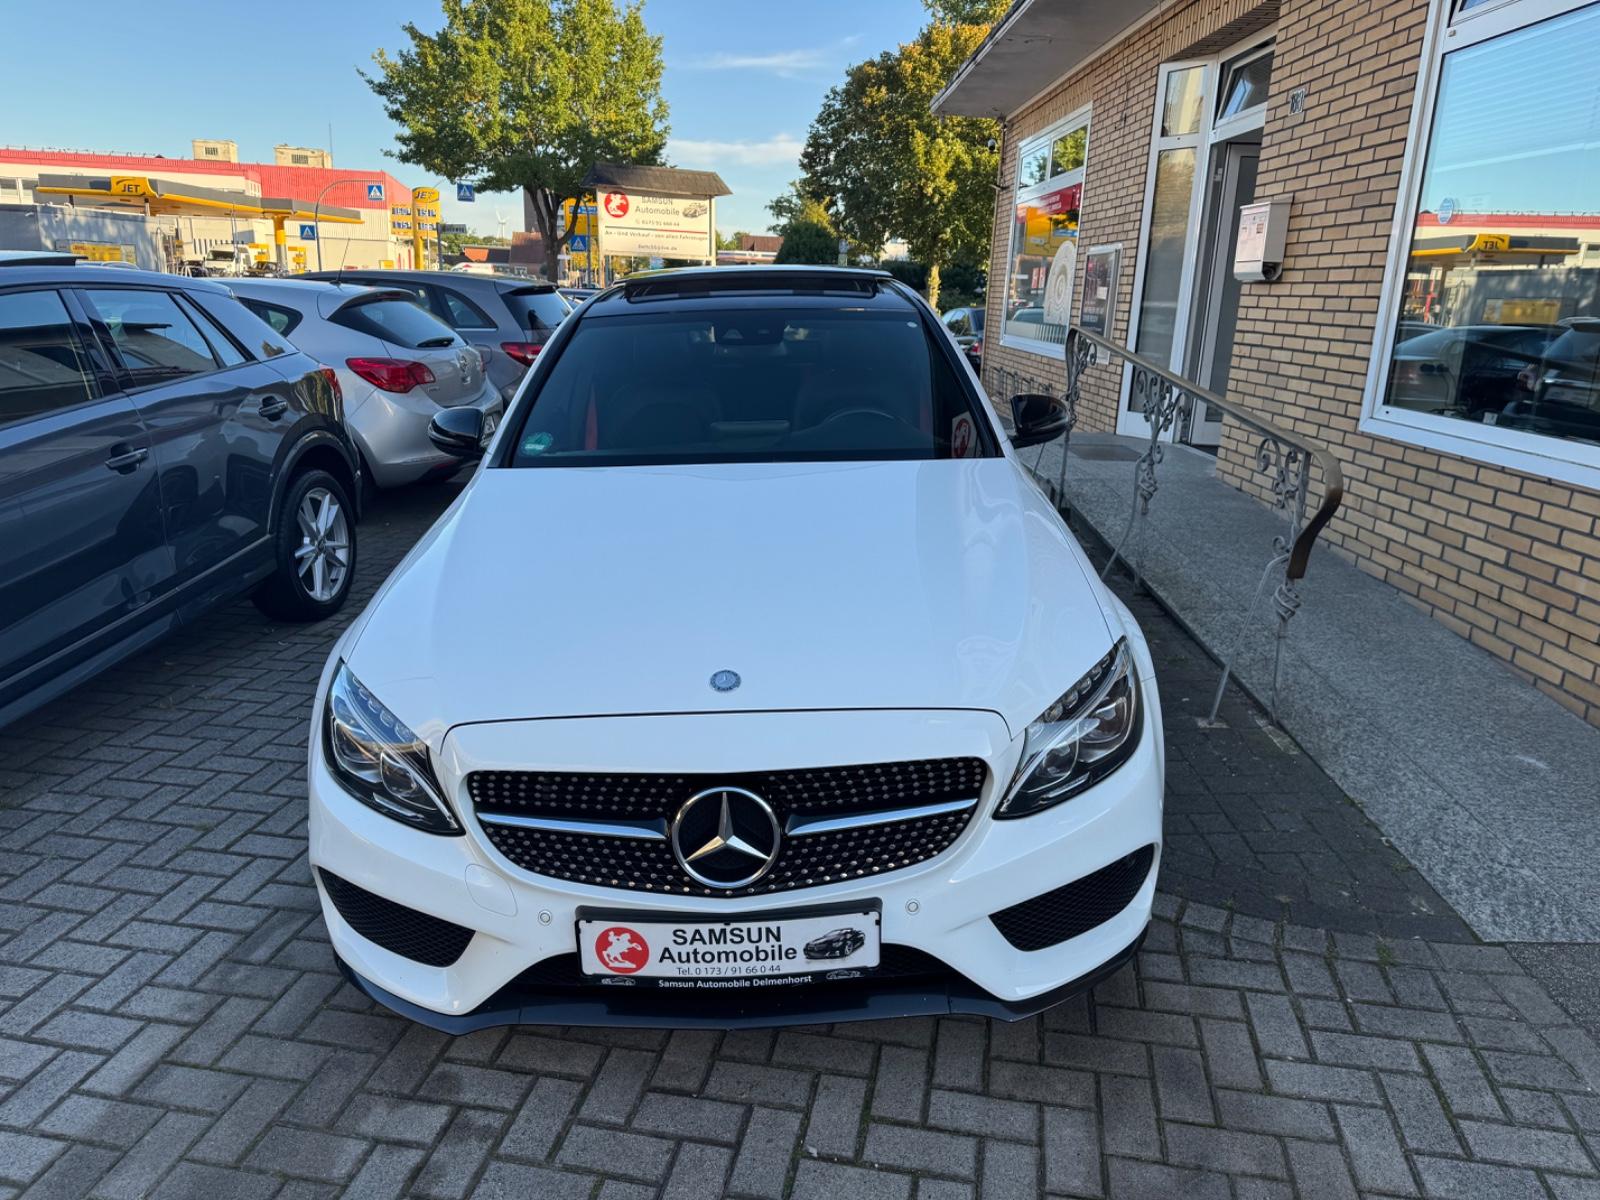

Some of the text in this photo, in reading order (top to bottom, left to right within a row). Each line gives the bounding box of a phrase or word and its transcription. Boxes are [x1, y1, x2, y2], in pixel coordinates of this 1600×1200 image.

[122, 184, 140, 192] JET
[635, 206, 680, 216] Automobile
[672, 926, 781, 945] SAMSUN
[658, 944, 797, 963] Automobile
[677, 967, 694, 976] Tel.
[705, 967, 722, 976] 173
[724, 966, 729, 976] /
[731, 966, 742, 975] 91
[769, 964, 781, 972] 44
[658, 975, 812, 988] Samsun Automobile Delmenhorst
